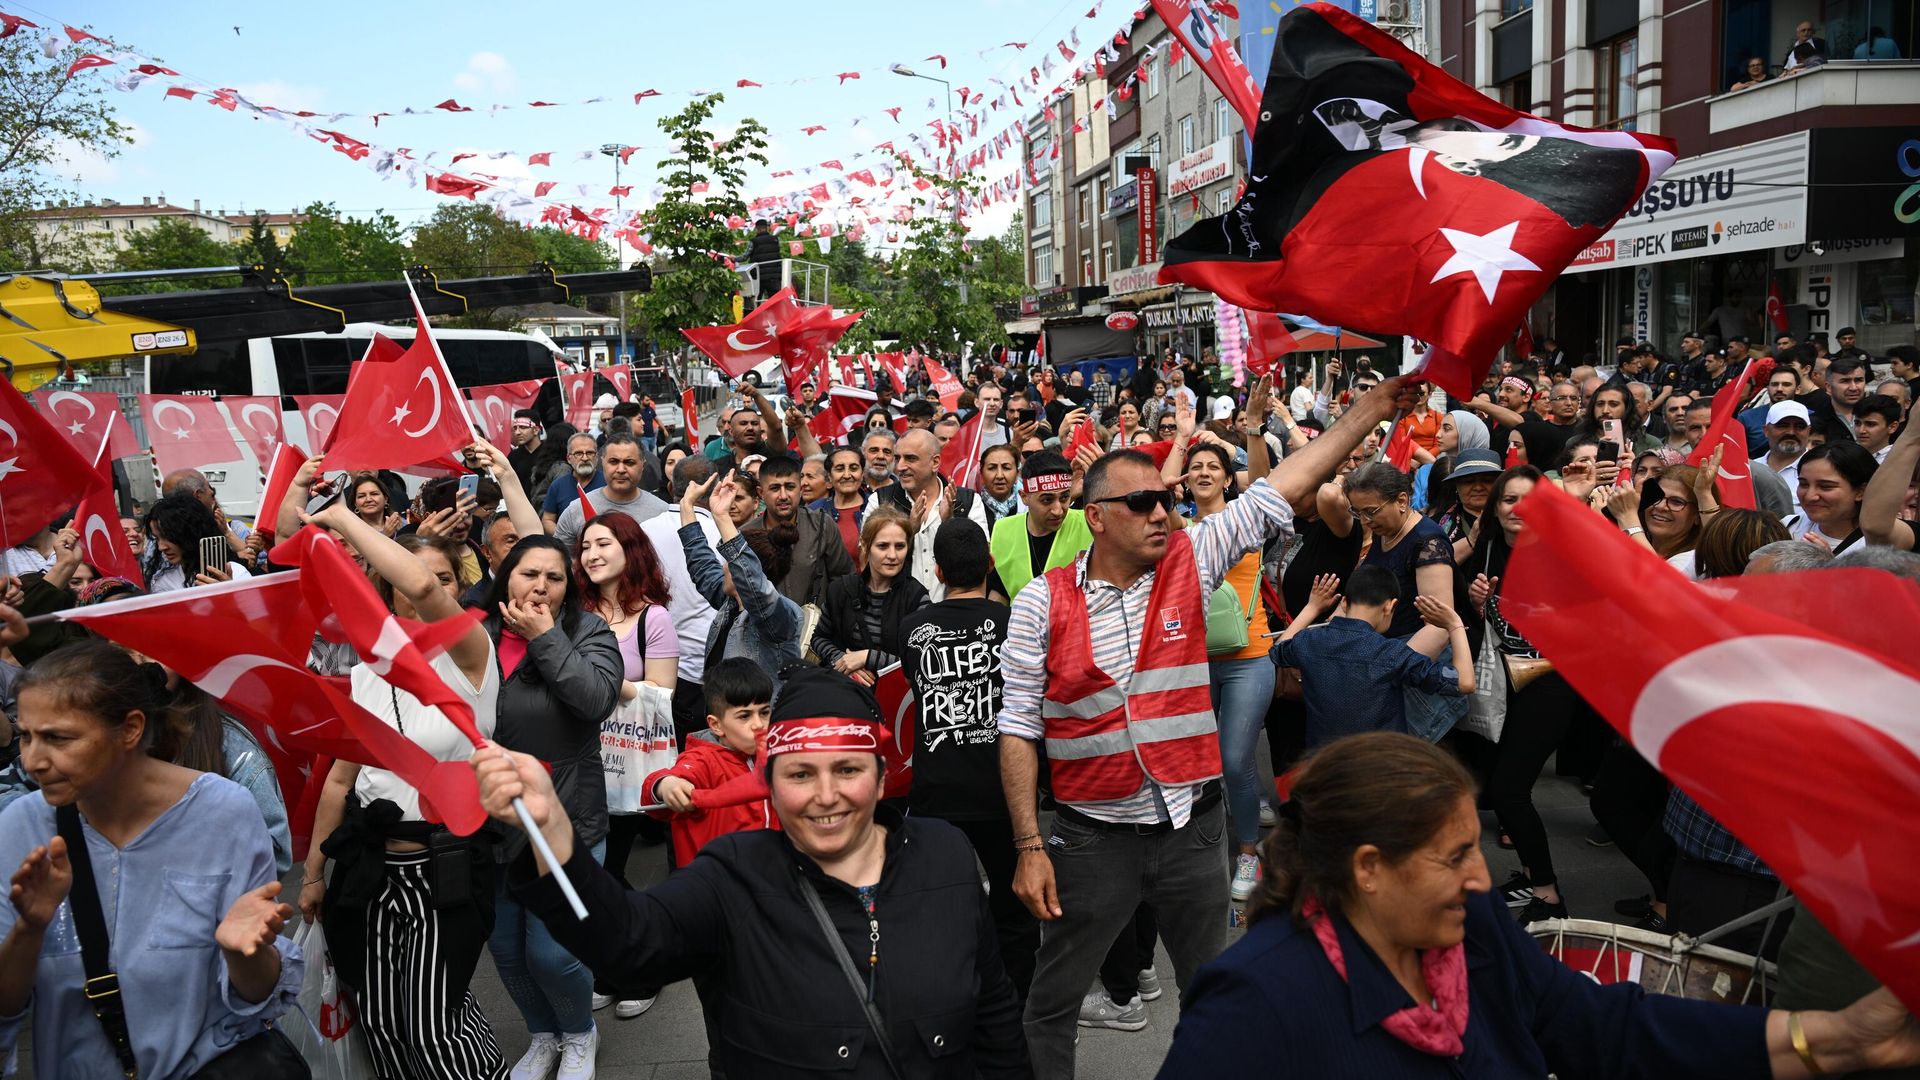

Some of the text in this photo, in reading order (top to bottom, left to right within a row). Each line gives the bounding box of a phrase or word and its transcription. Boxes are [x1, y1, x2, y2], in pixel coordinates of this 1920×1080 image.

[1673, 228, 1707, 243] ARTEMİS
[1727, 217, 1775, 240] şehzade
[1144, 233, 1152, 265] KURS
[1113, 272, 1158, 293] CANMA
[1145, 309, 1175, 327] DURAK
[1038, 474, 1056, 483] BEN
[1166, 621, 1180, 629] CHP
[922, 679, 993, 731] FRESH
